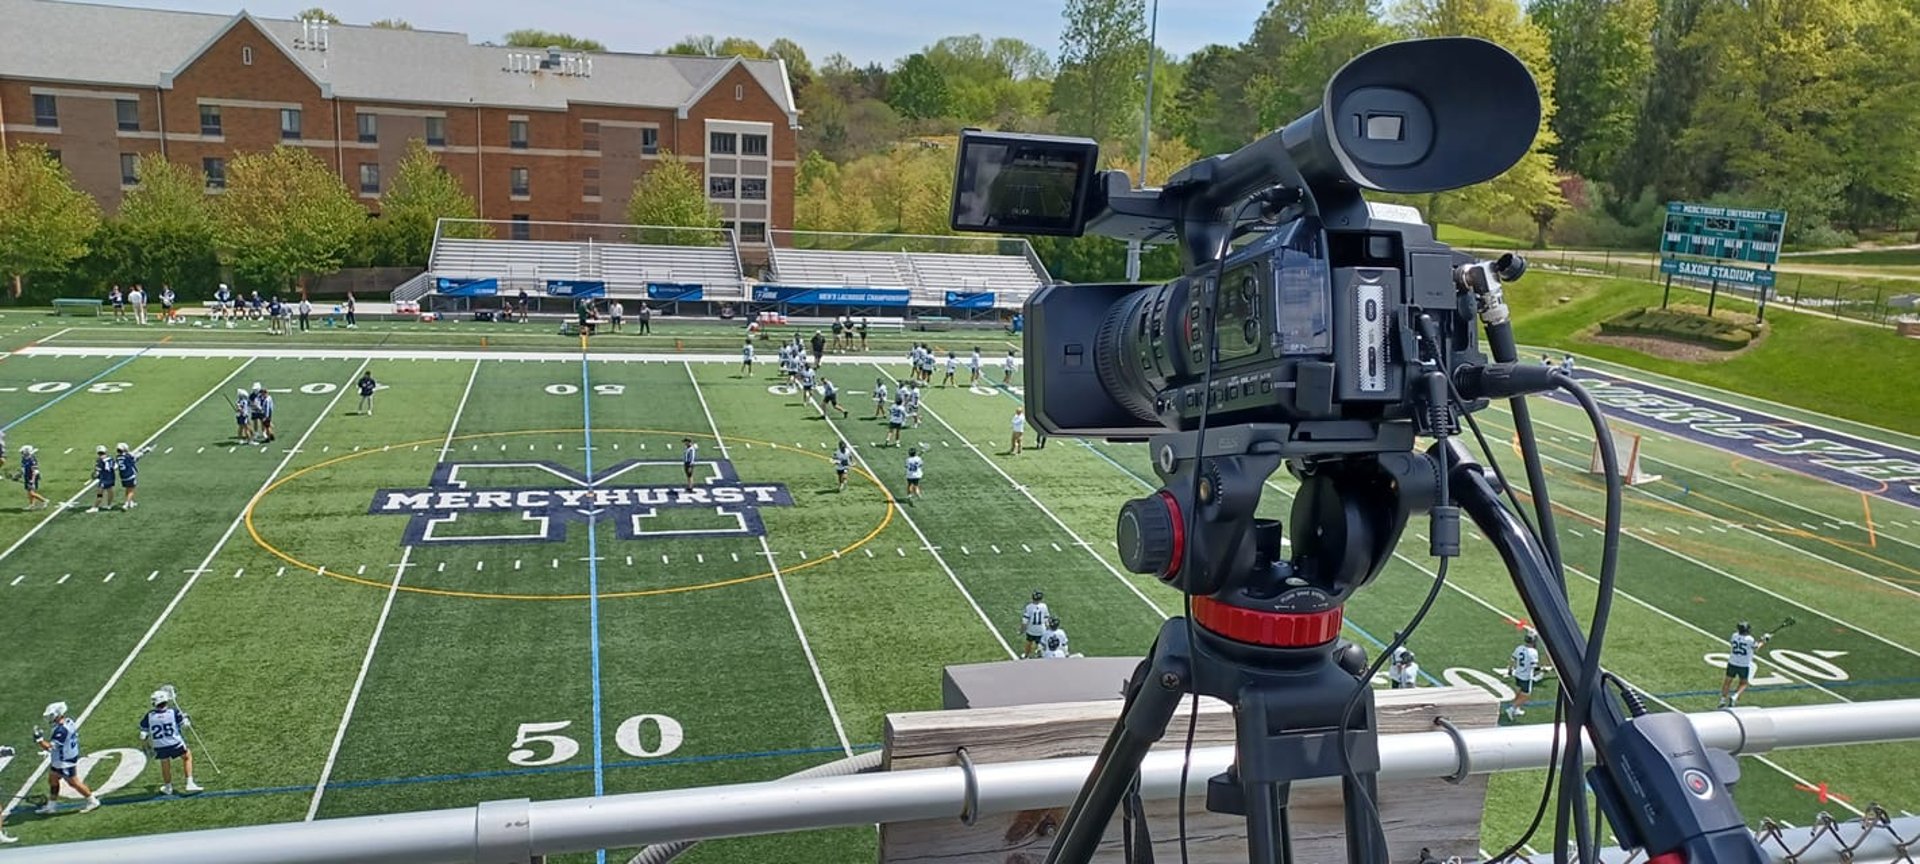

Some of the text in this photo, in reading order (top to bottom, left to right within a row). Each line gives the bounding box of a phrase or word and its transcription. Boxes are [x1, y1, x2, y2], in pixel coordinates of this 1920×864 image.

[1678, 262, 1755, 282] SAXON STADIUM
[838, 293, 865, 301] LACROSSE
[866, 293, 908, 302] CHAMPIONSHIP
[382, 486, 778, 510] MERCYHURST
[1032, 611, 1042, 625] 11
[1731, 640, 1748, 656] 25
[1518, 652, 1526, 667] 2
[150, 722, 175, 740] 25
[507, 713, 684, 767] 50
